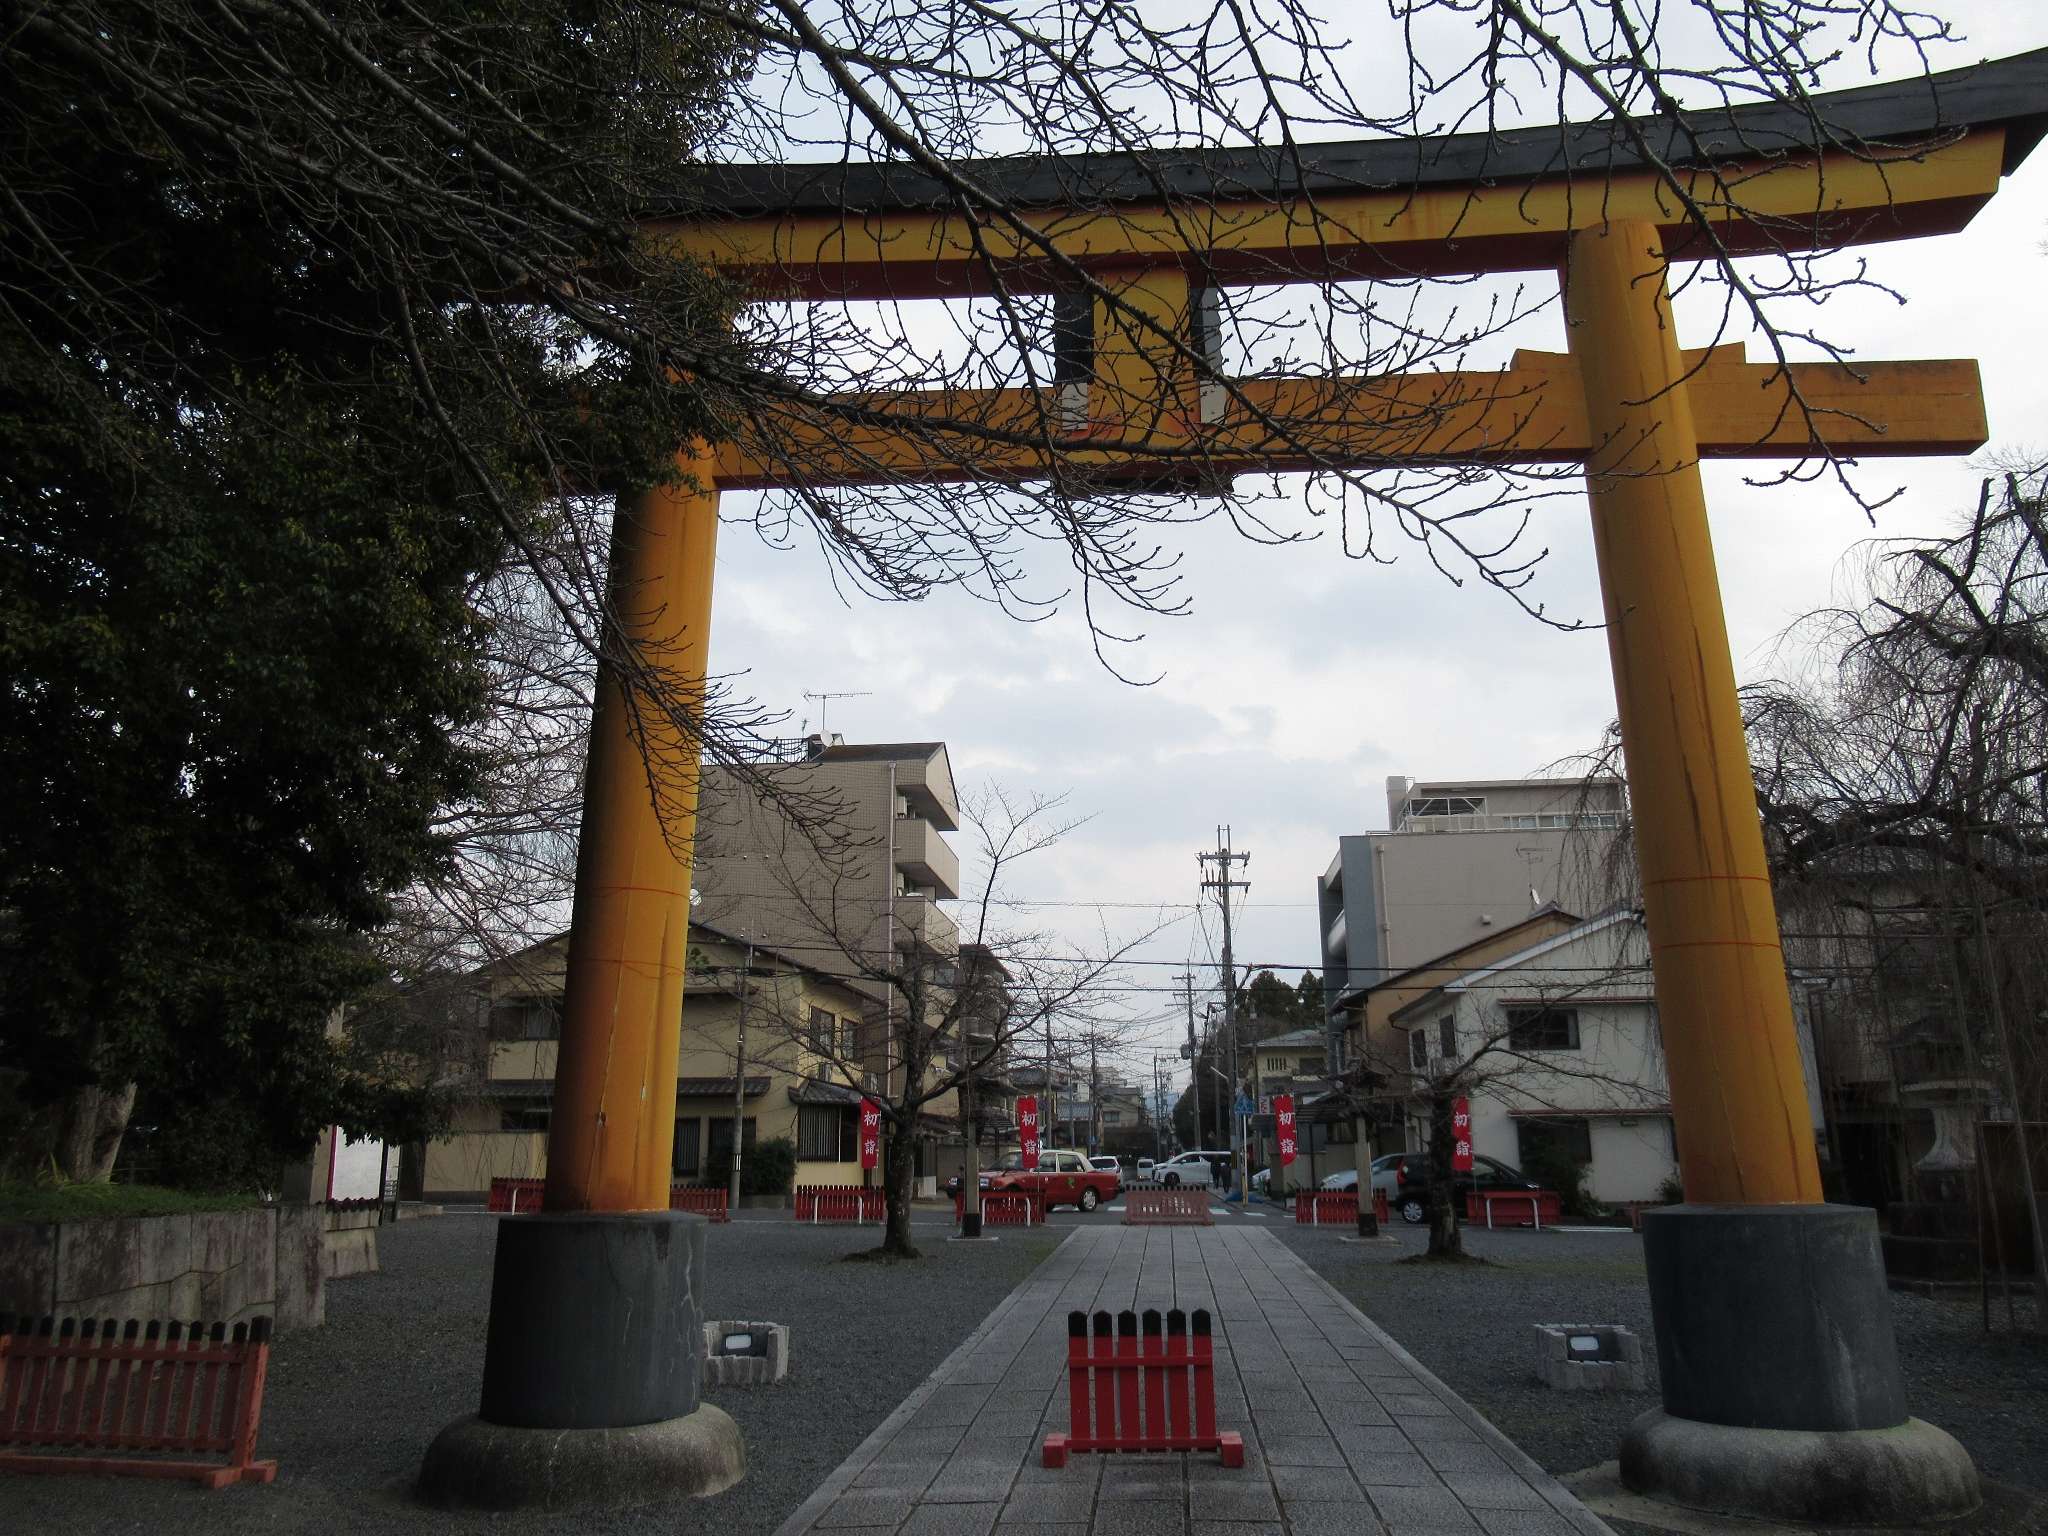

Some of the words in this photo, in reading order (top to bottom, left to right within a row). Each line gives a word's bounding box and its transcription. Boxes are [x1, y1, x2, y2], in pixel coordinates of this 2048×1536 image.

[864, 1111, 878, 1155] 初詣
[1022, 1111, 1037, 1155] 初詣
[1279, 1110, 1294, 1154] 初詣
[1454, 1112, 1470, 1156] 初詣
